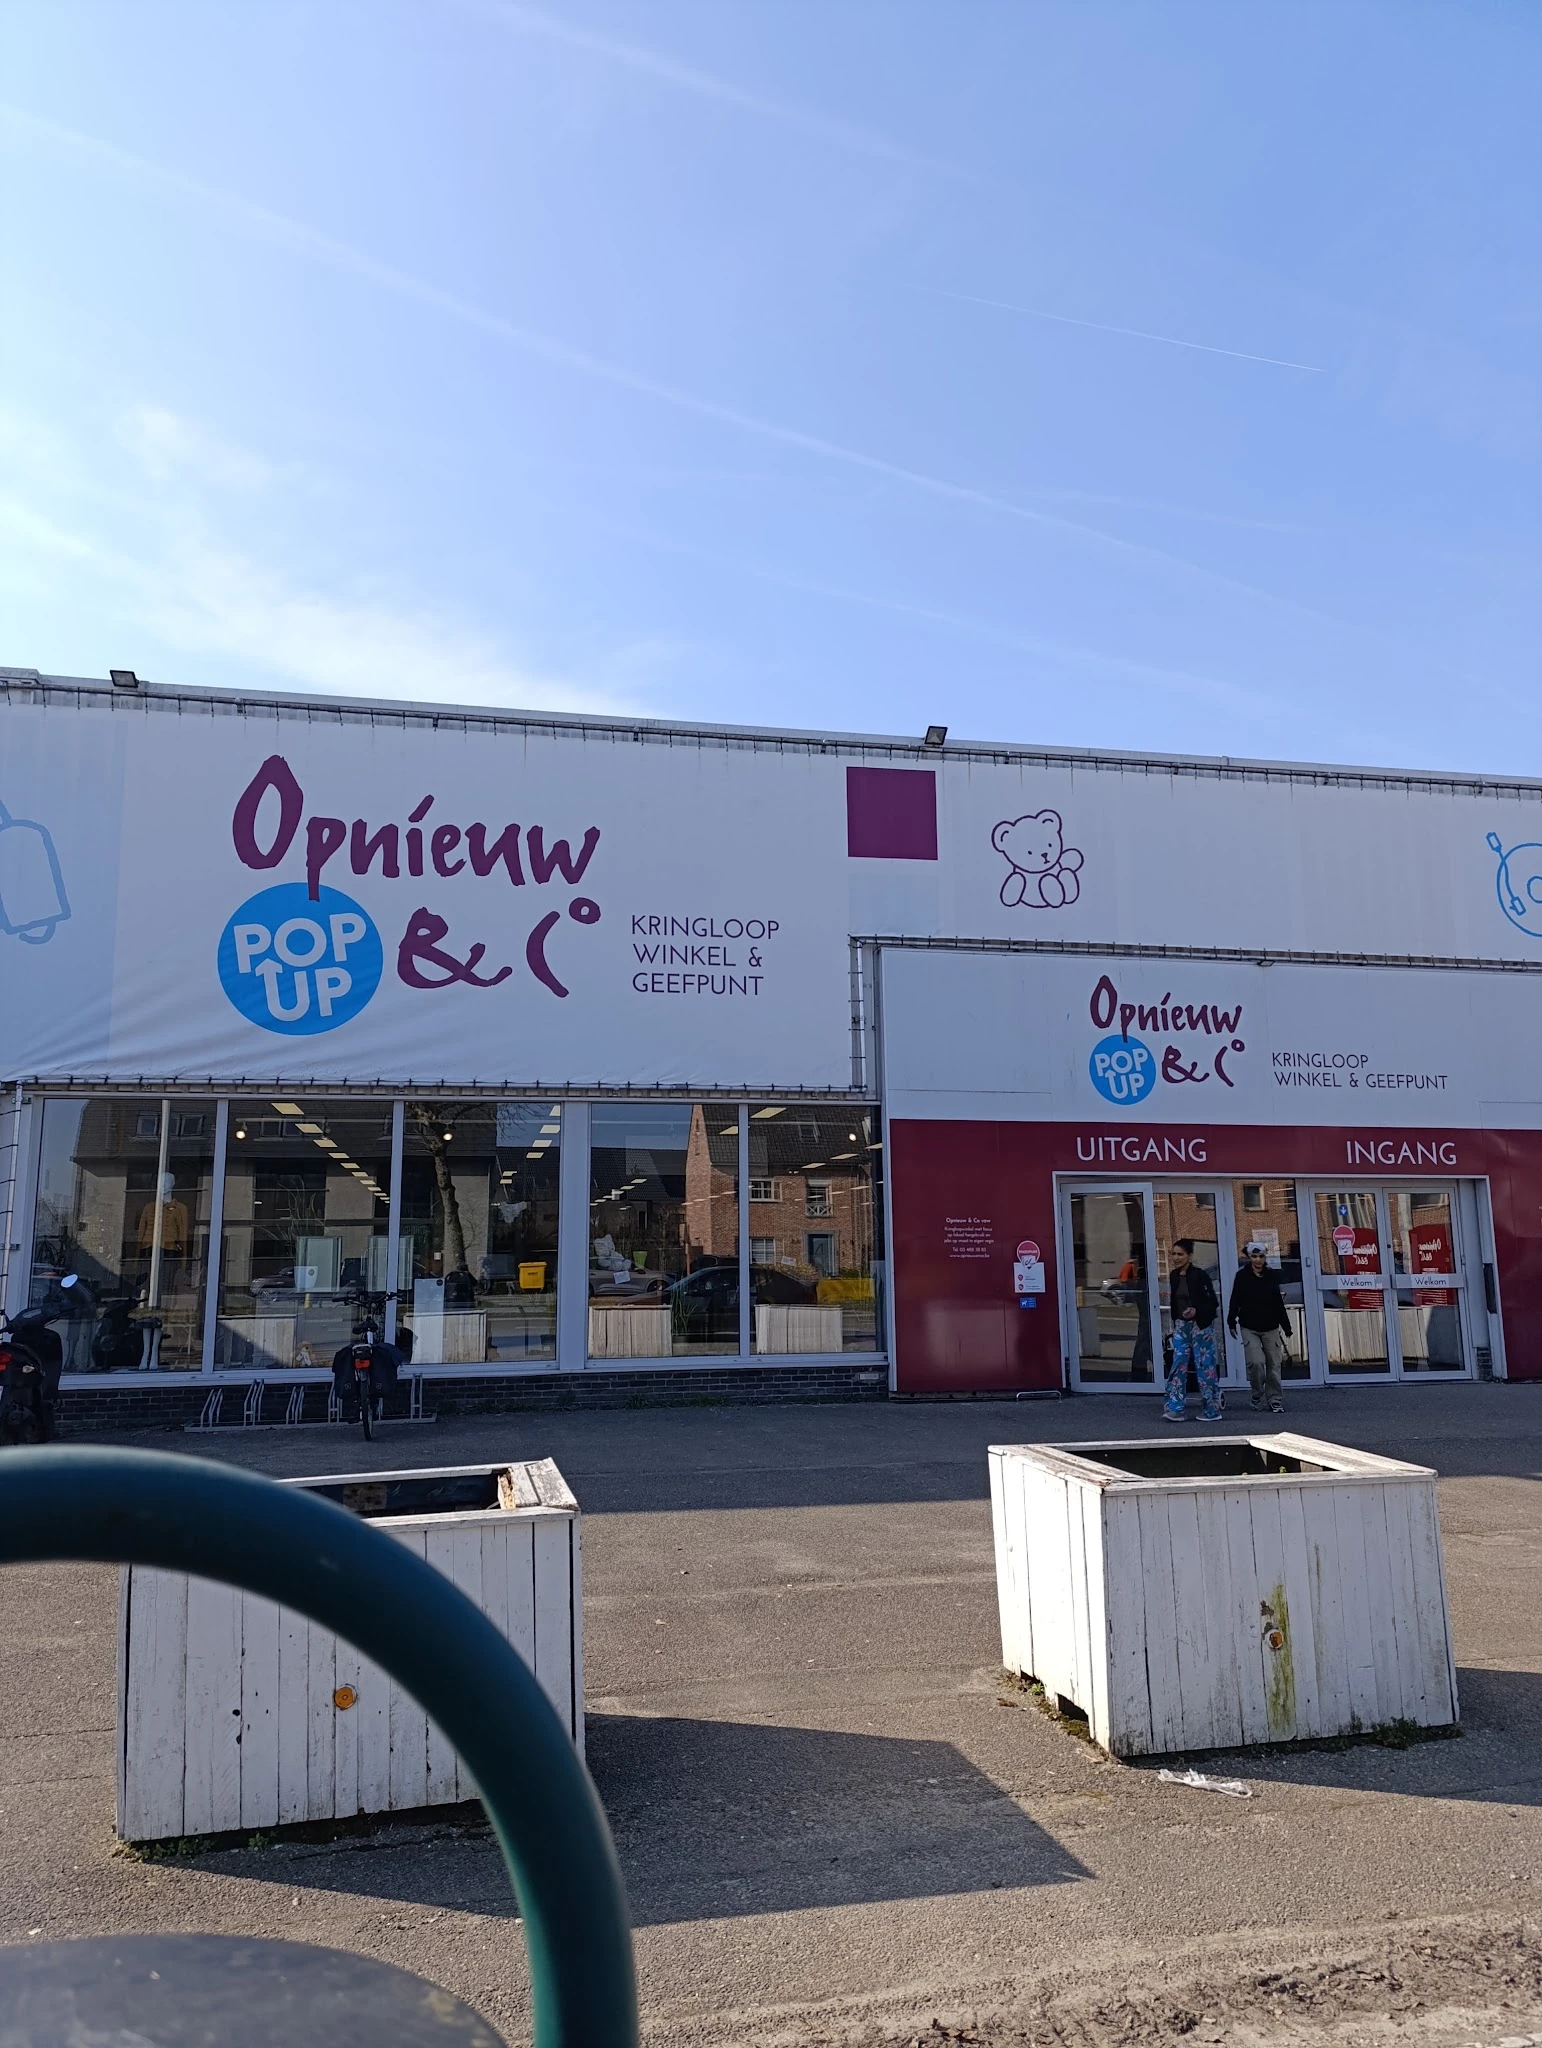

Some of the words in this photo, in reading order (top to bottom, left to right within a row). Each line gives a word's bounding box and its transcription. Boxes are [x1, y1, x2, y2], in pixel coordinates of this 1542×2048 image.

[231, 754, 601, 902] Opnieuw
[631, 914, 780, 940] KRINGLOOP
[233, 912, 367, 974] POP
[397, 906, 513, 989] &
[632, 943, 737, 967] WINKEL
[747, 946, 763, 968] &
[255, 958, 353, 1022] UP
[631, 972, 764, 996] GEEFPUNT
[1089, 974, 1243, 1044] Opnieuw
[1094, 1047, 1149, 1077] POP
[1161, 1045, 1210, 1084] &
[1271, 1052, 1369, 1069] KRINGLOOP
[1104, 1069, 1145, 1100] UP
[1273, 1071, 1342, 1088] WINKEL
[1349, 1072, 1359, 1088] &
[1365, 1073, 1448, 1090] GEEFPUNT
[1075, 1136, 1208, 1163] UITGANG
[1345, 1140, 1458, 1166] INGANG
[1340, 1278, 1373, 1287] Welkom
[1415, 1277, 1447, 1286] Welkom
